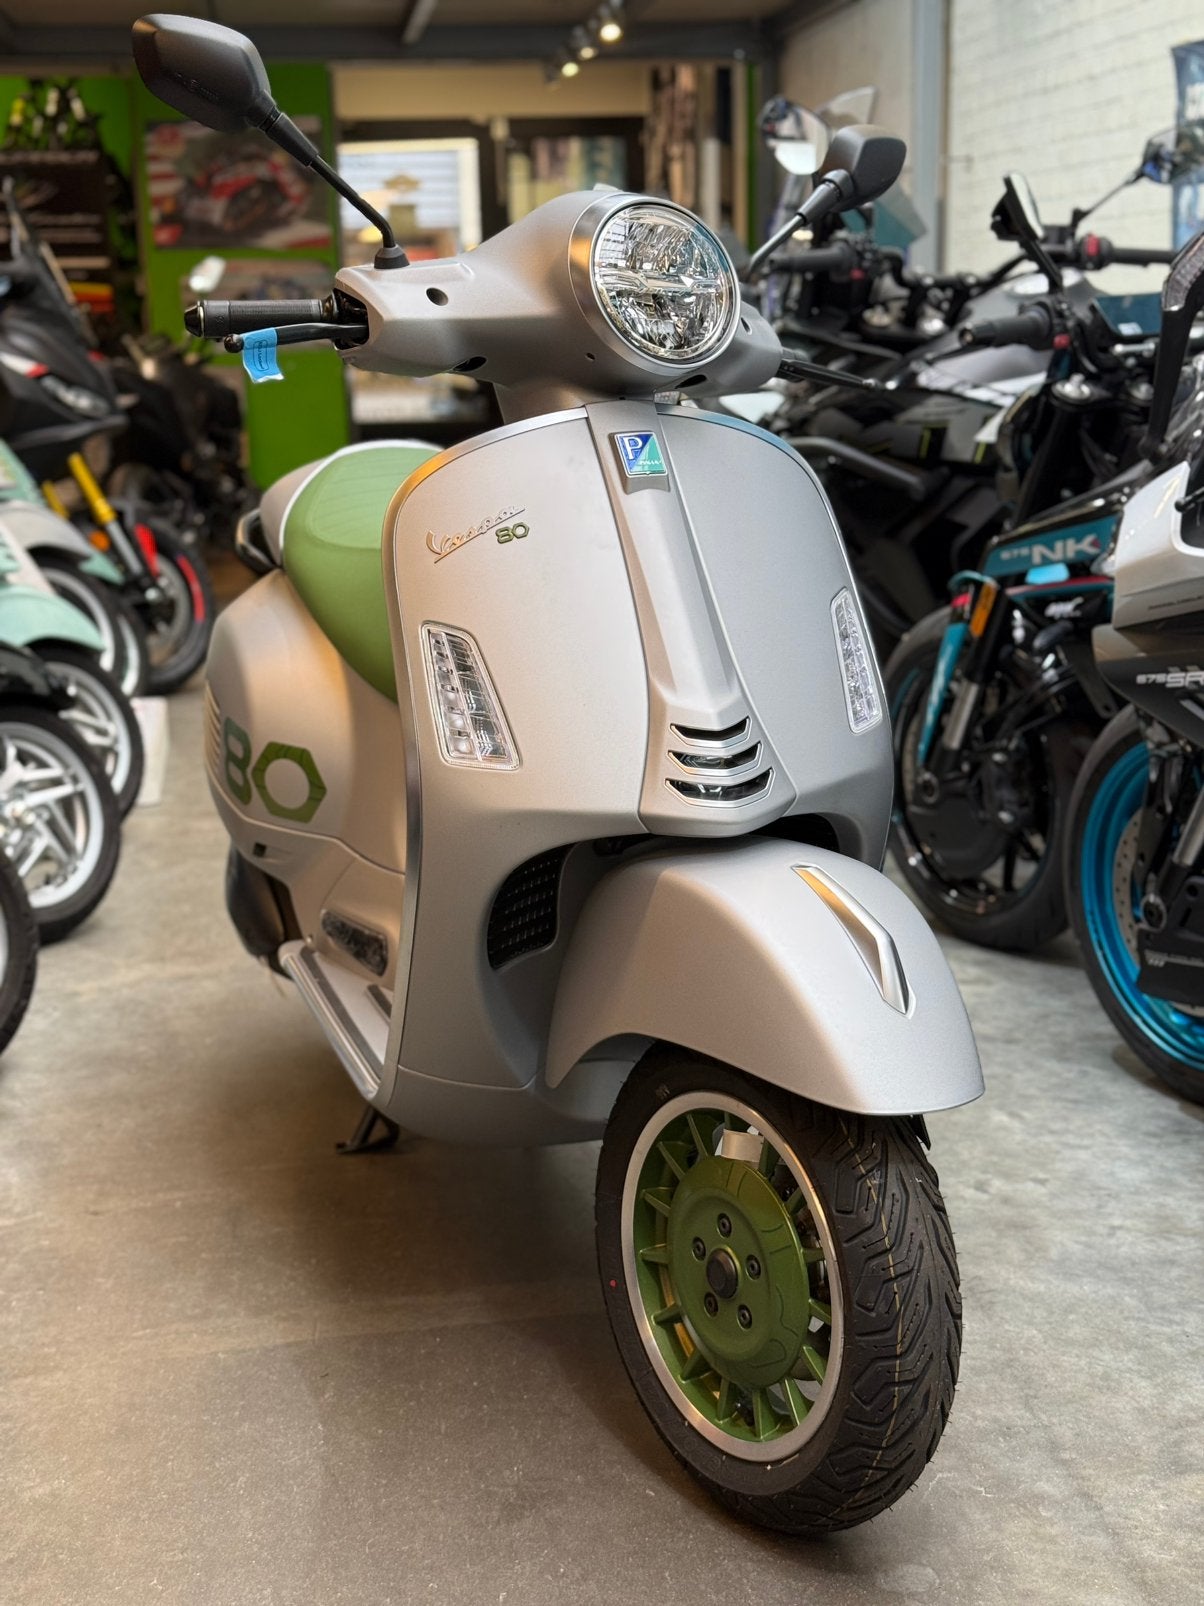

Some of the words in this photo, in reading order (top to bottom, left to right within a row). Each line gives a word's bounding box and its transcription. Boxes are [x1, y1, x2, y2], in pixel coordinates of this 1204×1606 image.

[622, 436, 643, 460] P
[495, 522, 530, 545] 80
[223, 717, 327, 824] 80
